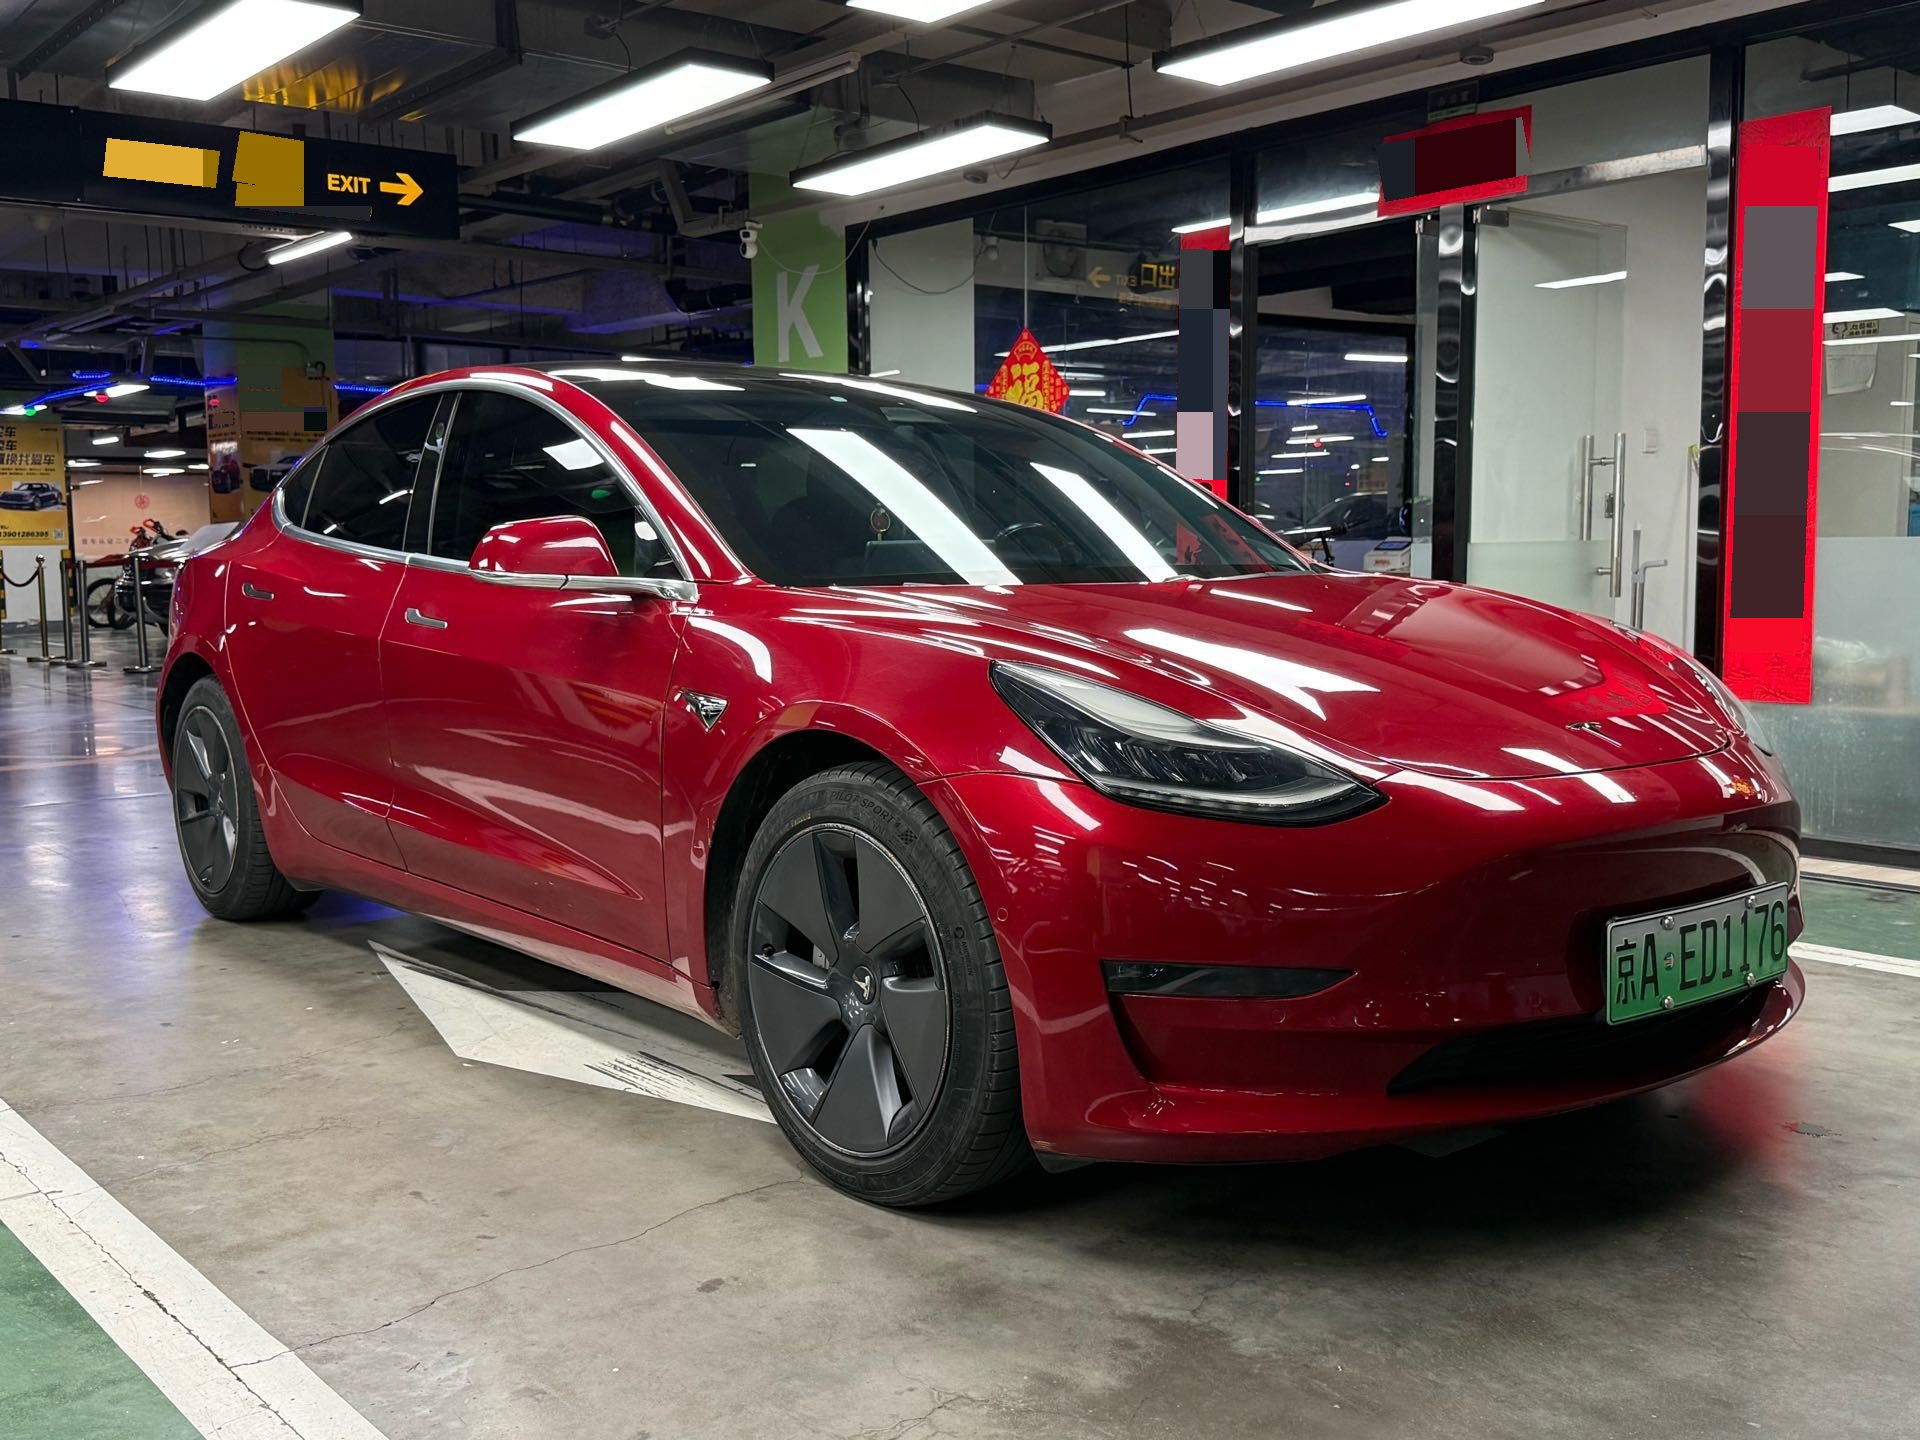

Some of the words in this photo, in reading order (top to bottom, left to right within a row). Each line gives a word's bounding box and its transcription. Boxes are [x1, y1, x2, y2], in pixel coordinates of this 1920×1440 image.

[327, 173, 371, 195] EXIT
[776, 265, 824, 363] K
[861, 798, 894, 825] SPORT
